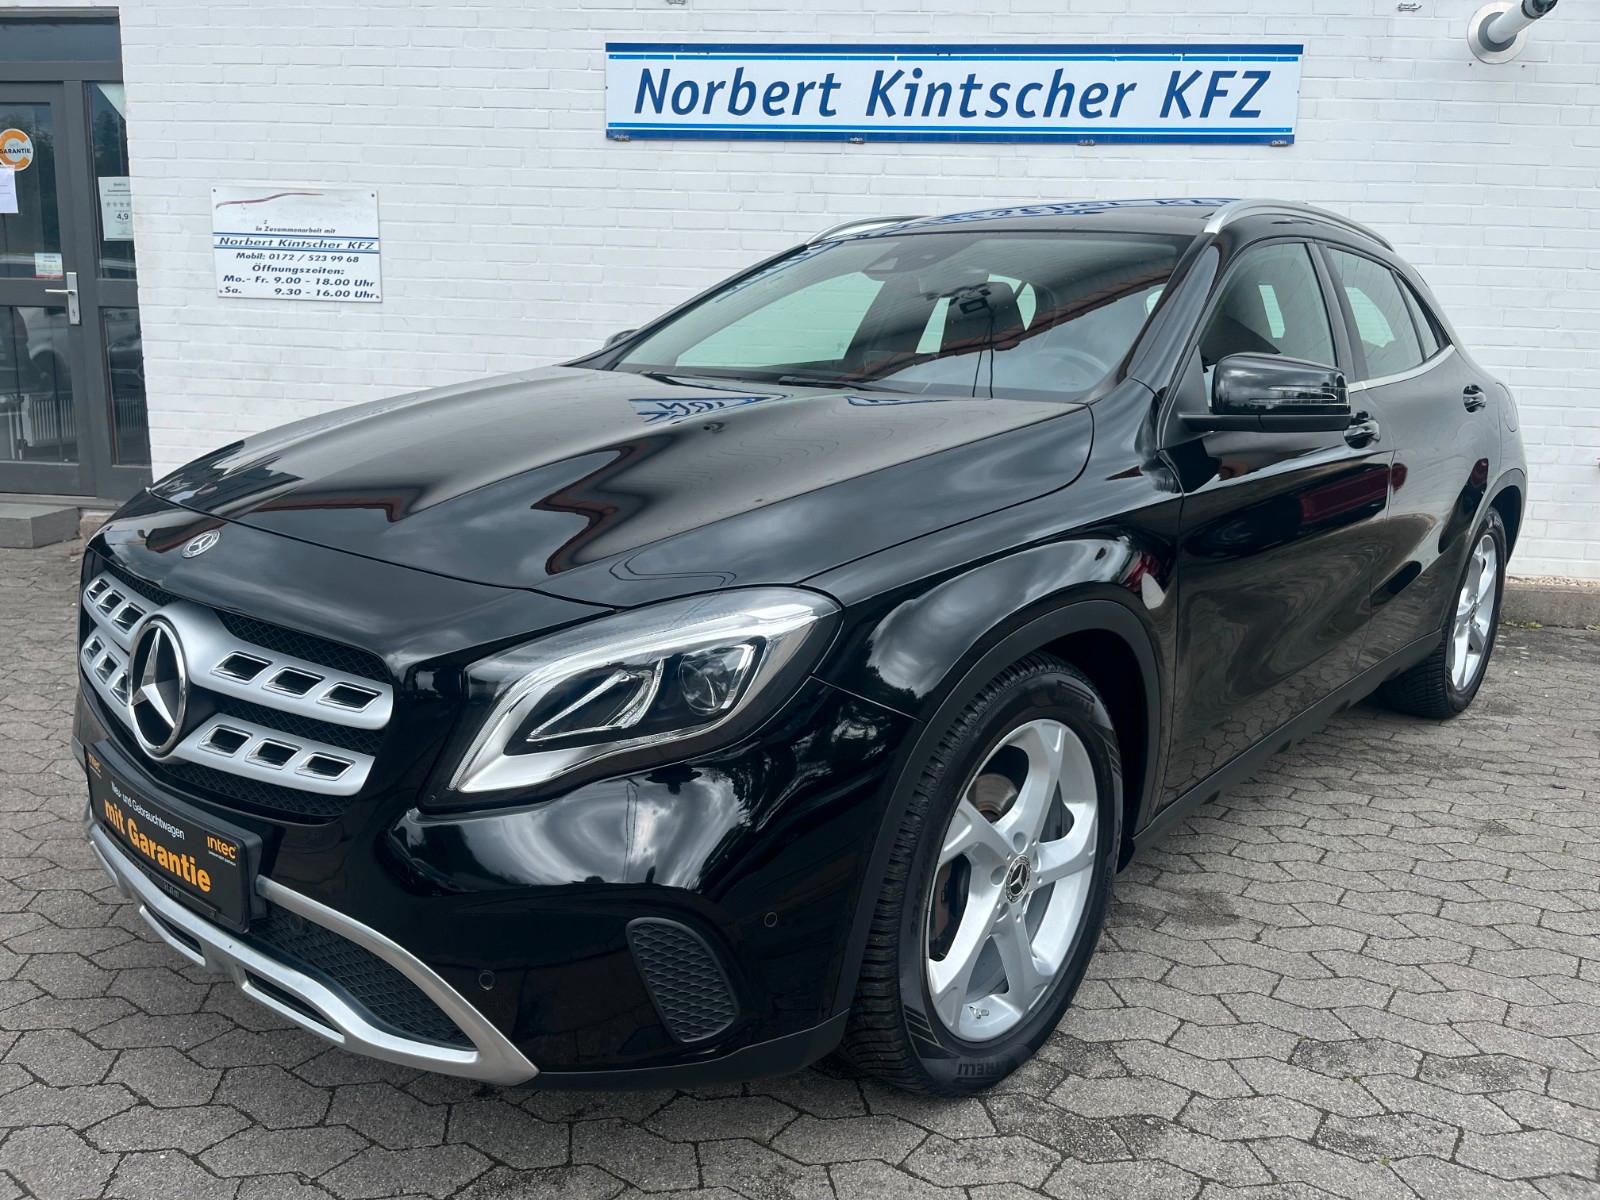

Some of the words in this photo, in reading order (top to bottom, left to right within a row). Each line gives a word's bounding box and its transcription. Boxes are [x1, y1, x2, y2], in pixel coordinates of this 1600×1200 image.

[634, 66, 842, 118] Norbert
[865, 67, 1138, 119] Kintscher
[1159, 69, 1271, 119] KFZ
[116, 213, 129, 221] 4,9
[219, 237, 273, 247] Norbert
[278, 239, 342, 249] Kintscher
[347, 241, 375, 250] KFZ
[236, 252, 266, 260] Mobil:
[269, 253, 295, 261] 0172
[252, 262, 345, 275] Öffnungszeiten:
[273, 276, 302, 284] 9.00
[316, 278, 350, 286] 18.00
[354, 279, 375, 287] Uhr
[224, 286, 242, 294] Sa.
[316, 289, 351, 297] 16.00
[122, 794, 132, 807] und
[132, 800, 185, 840] Gebrauchtwagen
[104, 800, 126, 835] mit
[127, 817, 212, 892] Garantie
